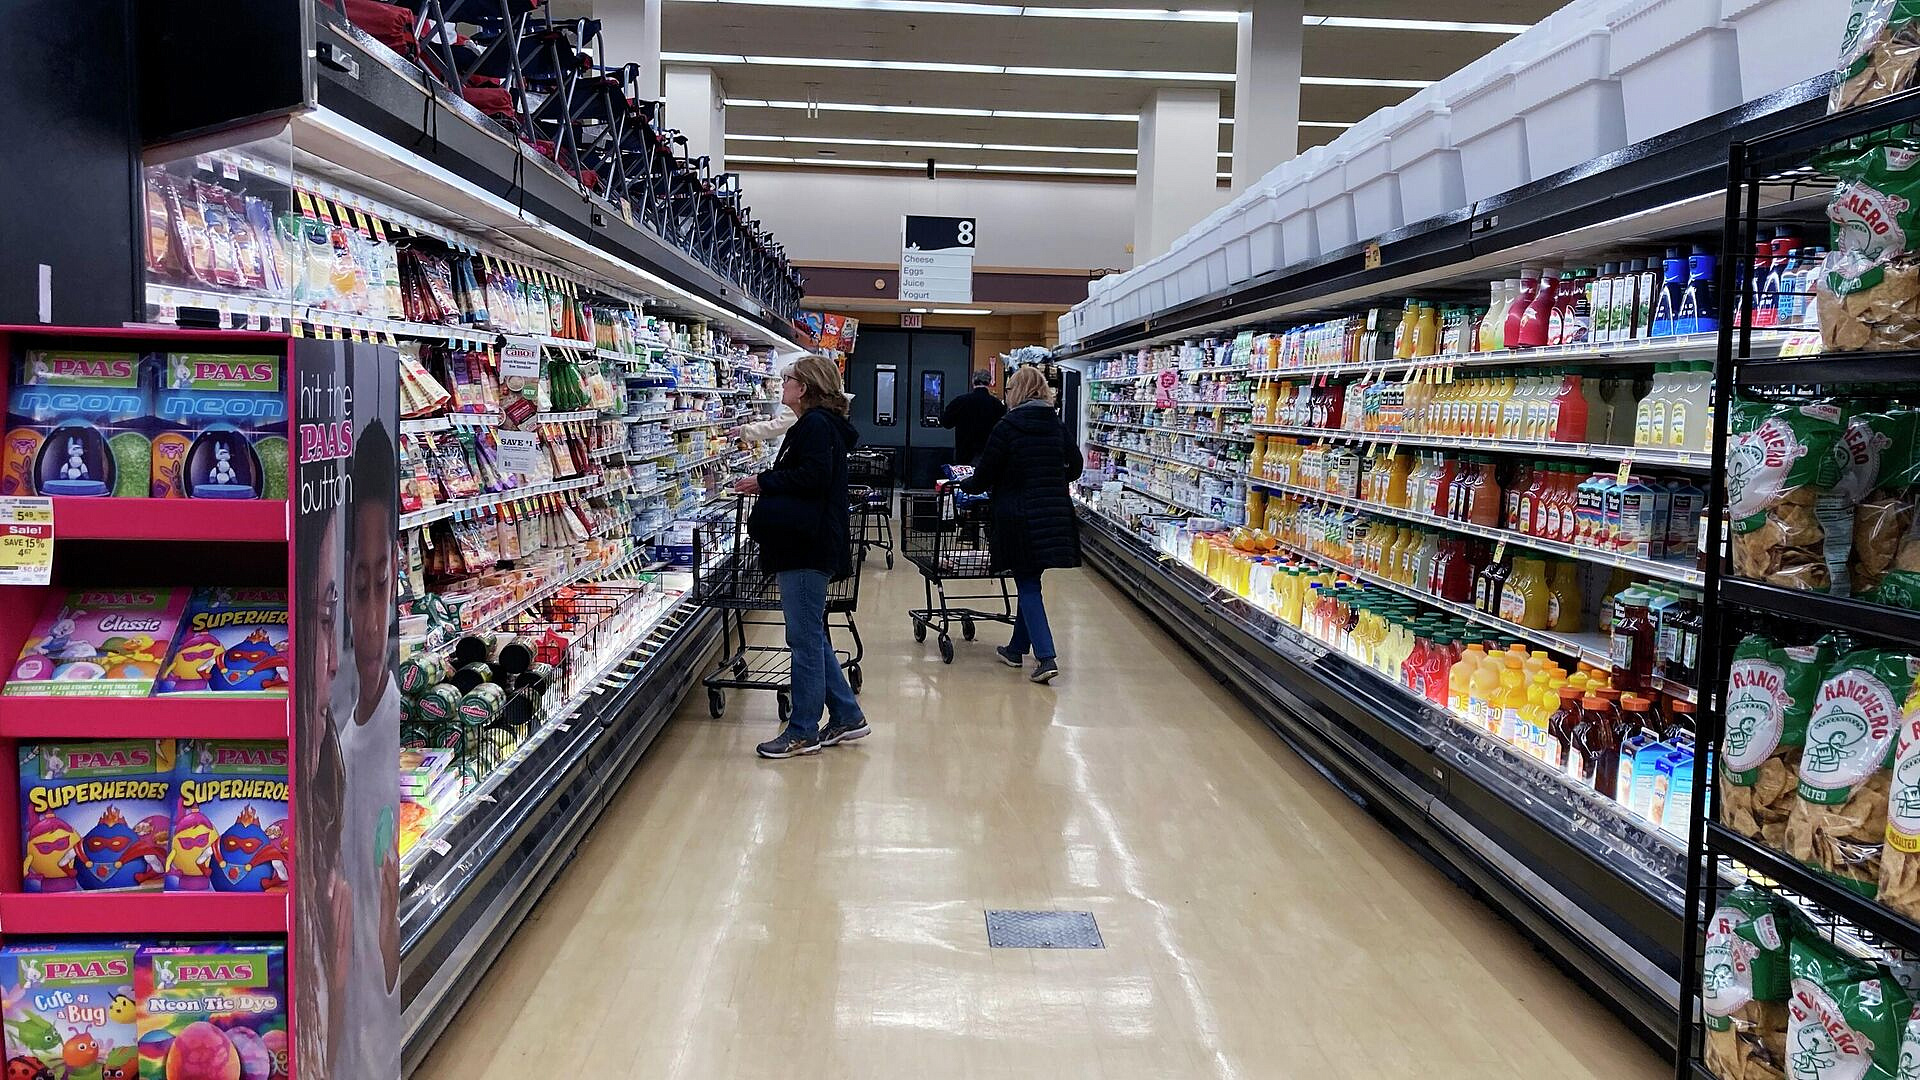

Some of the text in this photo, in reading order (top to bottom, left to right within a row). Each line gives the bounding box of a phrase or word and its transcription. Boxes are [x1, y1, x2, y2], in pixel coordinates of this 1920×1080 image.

[957, 220, 974, 245] 8
[904, 255, 934, 264] Cheese
[903, 267, 924, 276] Eggs
[902, 279, 925, 288] Juice
[903, 291, 929, 300] Yogurt
[903, 315, 920, 327] EXIT
[52, 358, 133, 379] PAAS
[194, 361, 273, 382] PAAS
[19, 393, 141, 412] neon
[301, 371, 353, 419] hit the
[165, 396, 284, 417] neon
[300, 420, 353, 464] PAAS
[501, 438, 524, 446] SAVE
[301, 464, 353, 514] button
[9, 525, 42, 534] Sale!
[25, 538, 45, 549] 15%
[80, 591, 157, 605] PAAS
[98, 614, 161, 633] Classic
[192, 610, 289, 632] SUPERHER
[1825, 680, 1889, 740] RANCHERO
[67, 750, 150, 770] PAAS
[215, 749, 288, 767] PAAS
[29, 780, 169, 812] SUPERHEROES
[1799, 784, 1827, 800] SALTED
[44, 959, 128, 980] PAAS
[178, 964, 254, 982] PAAS
[34, 990, 89, 1011] Cute as
[149, 996, 278, 1013] Neon Tie Dye
[57, 1005, 106, 1026] a Bug
